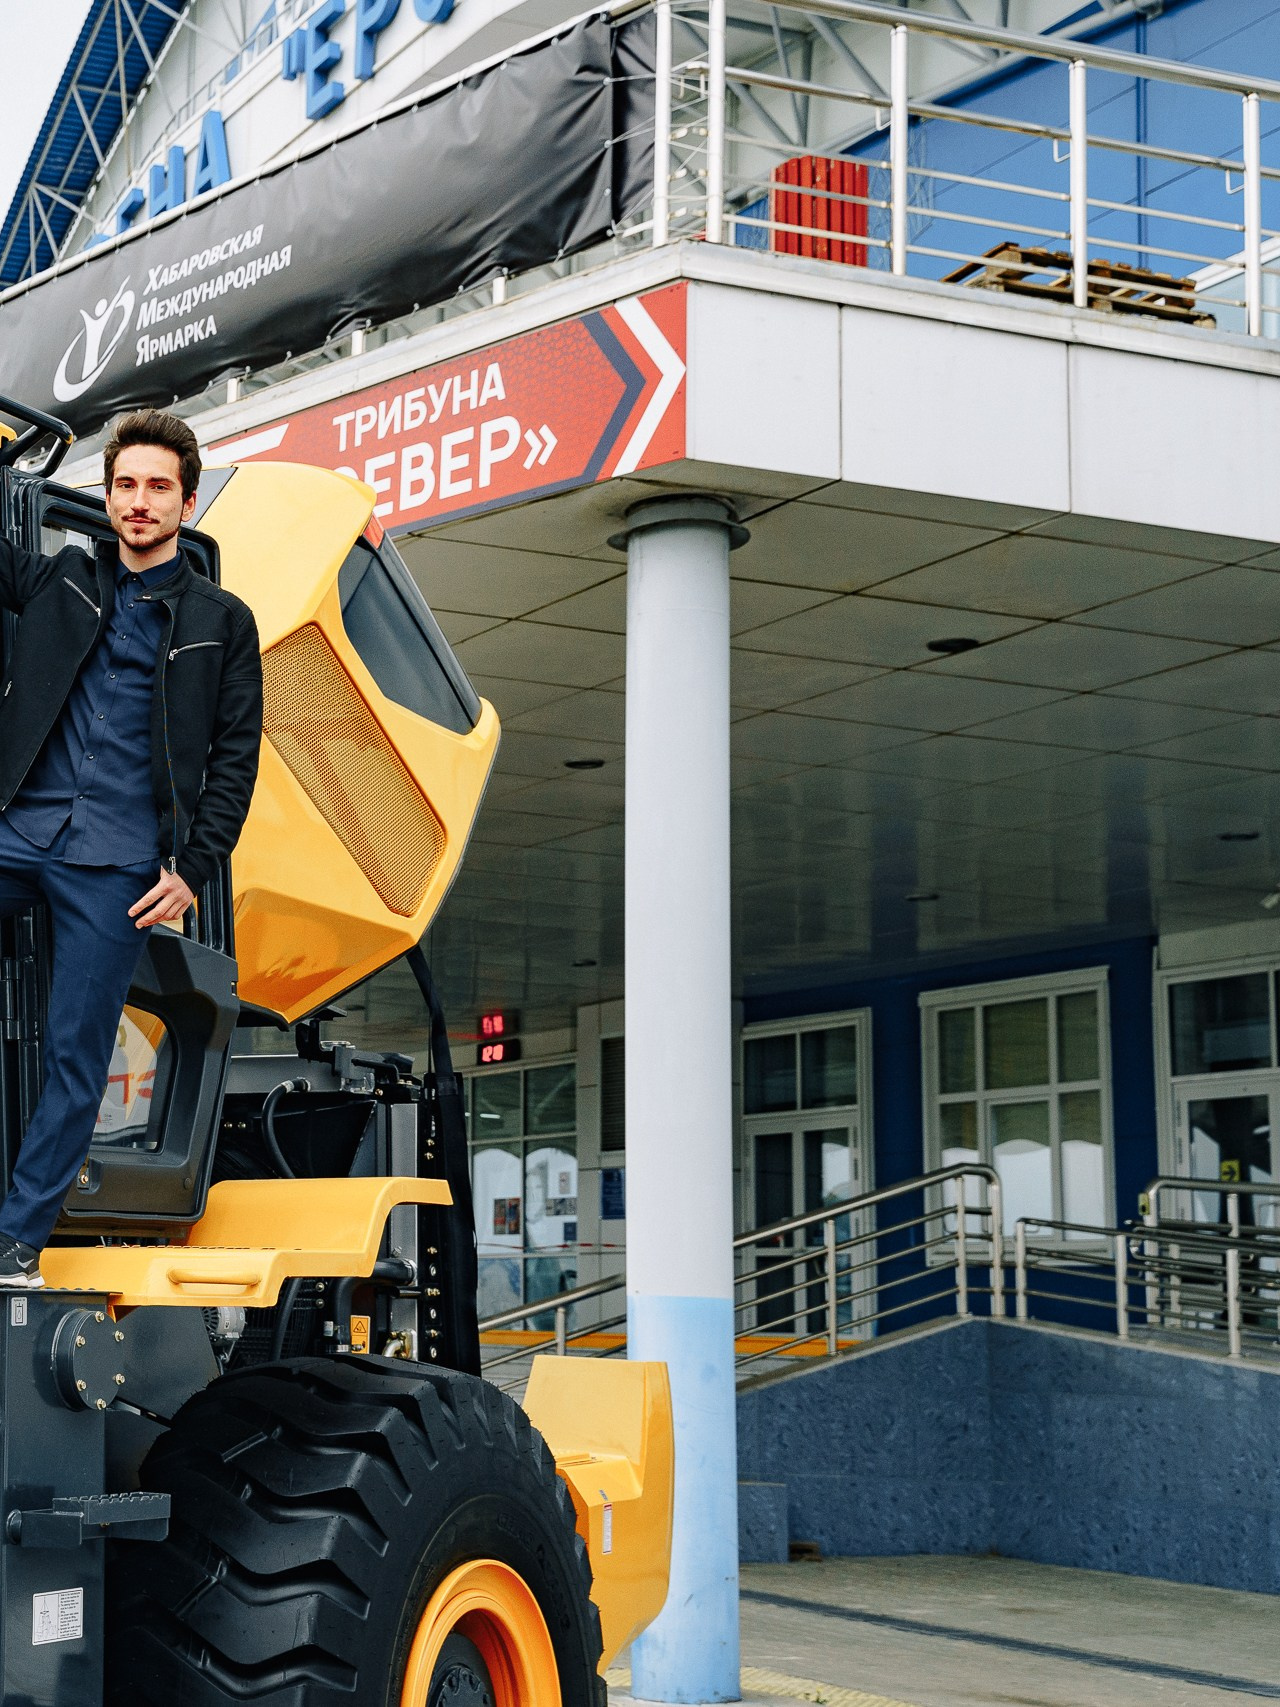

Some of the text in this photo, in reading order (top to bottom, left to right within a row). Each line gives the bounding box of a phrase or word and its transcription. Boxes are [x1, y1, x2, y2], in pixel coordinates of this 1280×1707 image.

[136, 244, 292, 331] МЕЖДУНАРОДНАЯ
[143, 224, 264, 297] ХАБАРОВСКАЯ
[135, 314, 218, 368] ЯРМАРКА
[332, 362, 507, 453] ТРИБУНА
